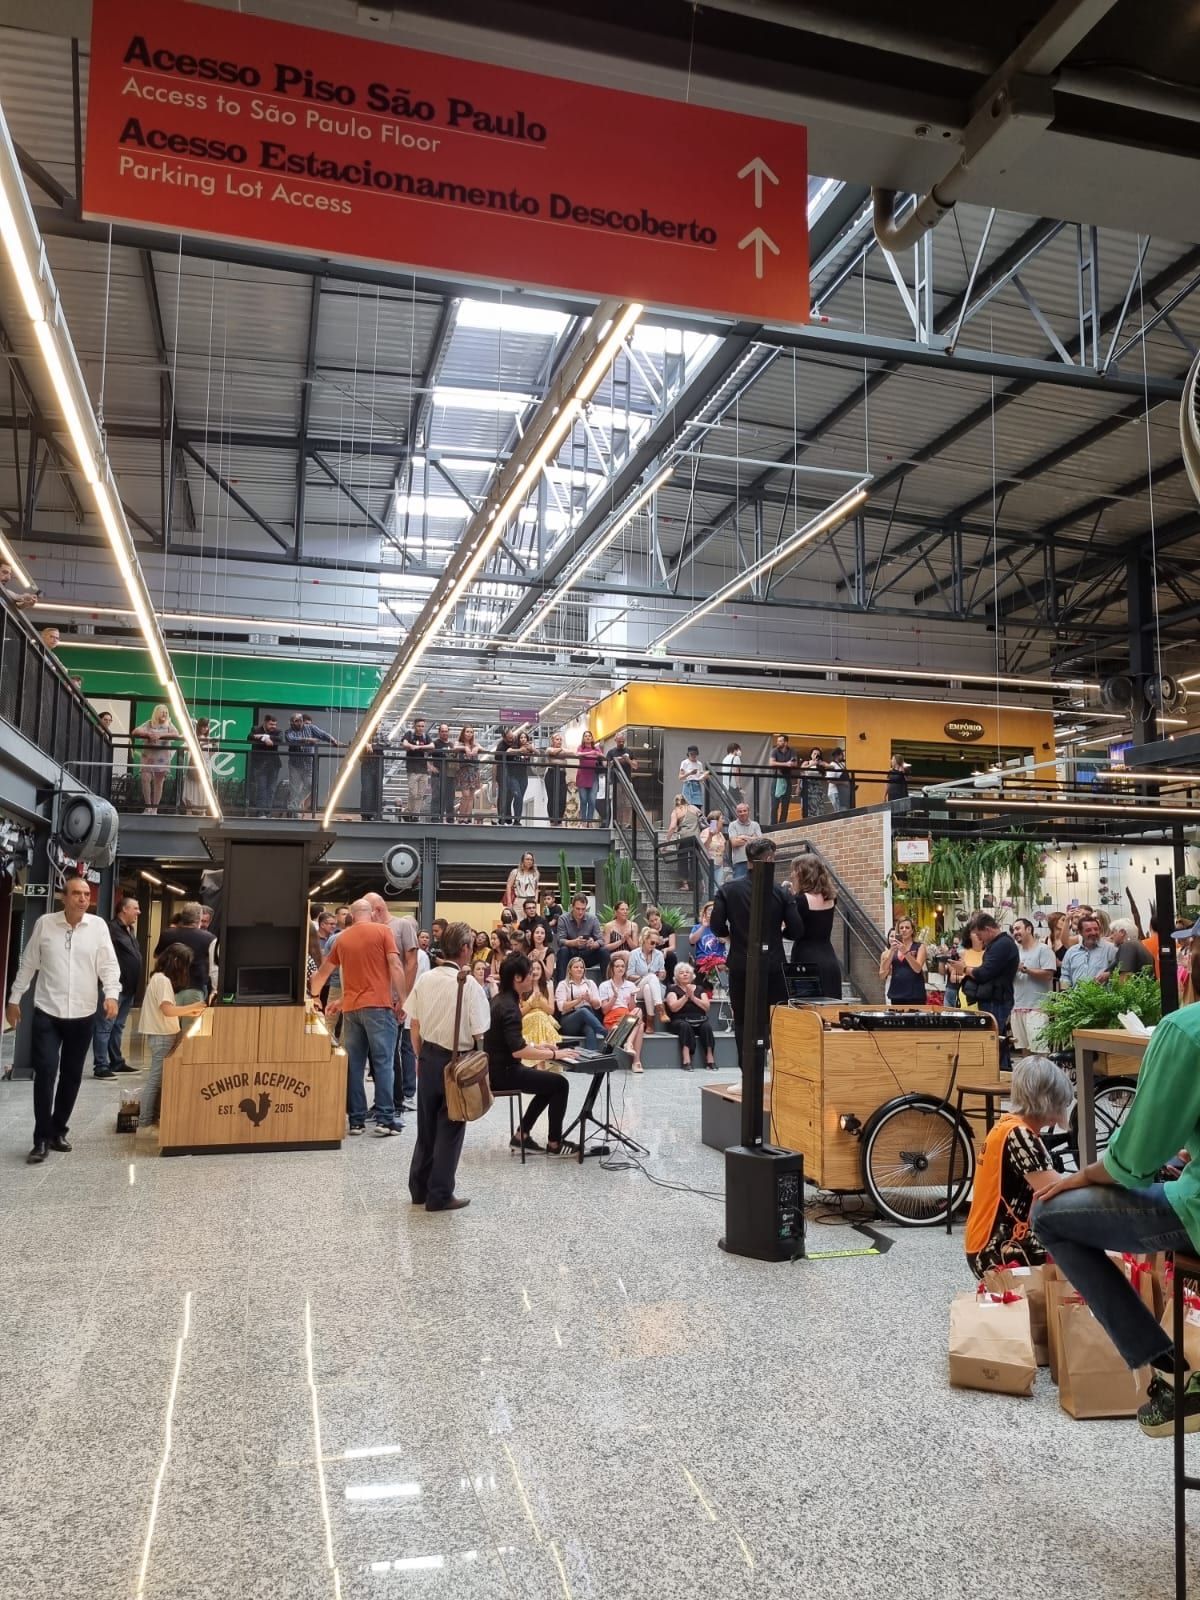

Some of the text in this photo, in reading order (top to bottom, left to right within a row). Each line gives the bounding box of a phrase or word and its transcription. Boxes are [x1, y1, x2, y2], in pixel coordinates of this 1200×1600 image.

[121, 77, 441, 153] Access to São Paulo Floor
[122, 36, 547, 143] Acesso Piso São Paulo
[118, 117, 717, 244] Acesso Estacionamento Descoberto
[119, 156, 352, 214] Parking Lot Access
[200, 1072, 311, 1101] SENHOR ACEPIPES
[218, 1103, 293, 1115] EST. 2015
